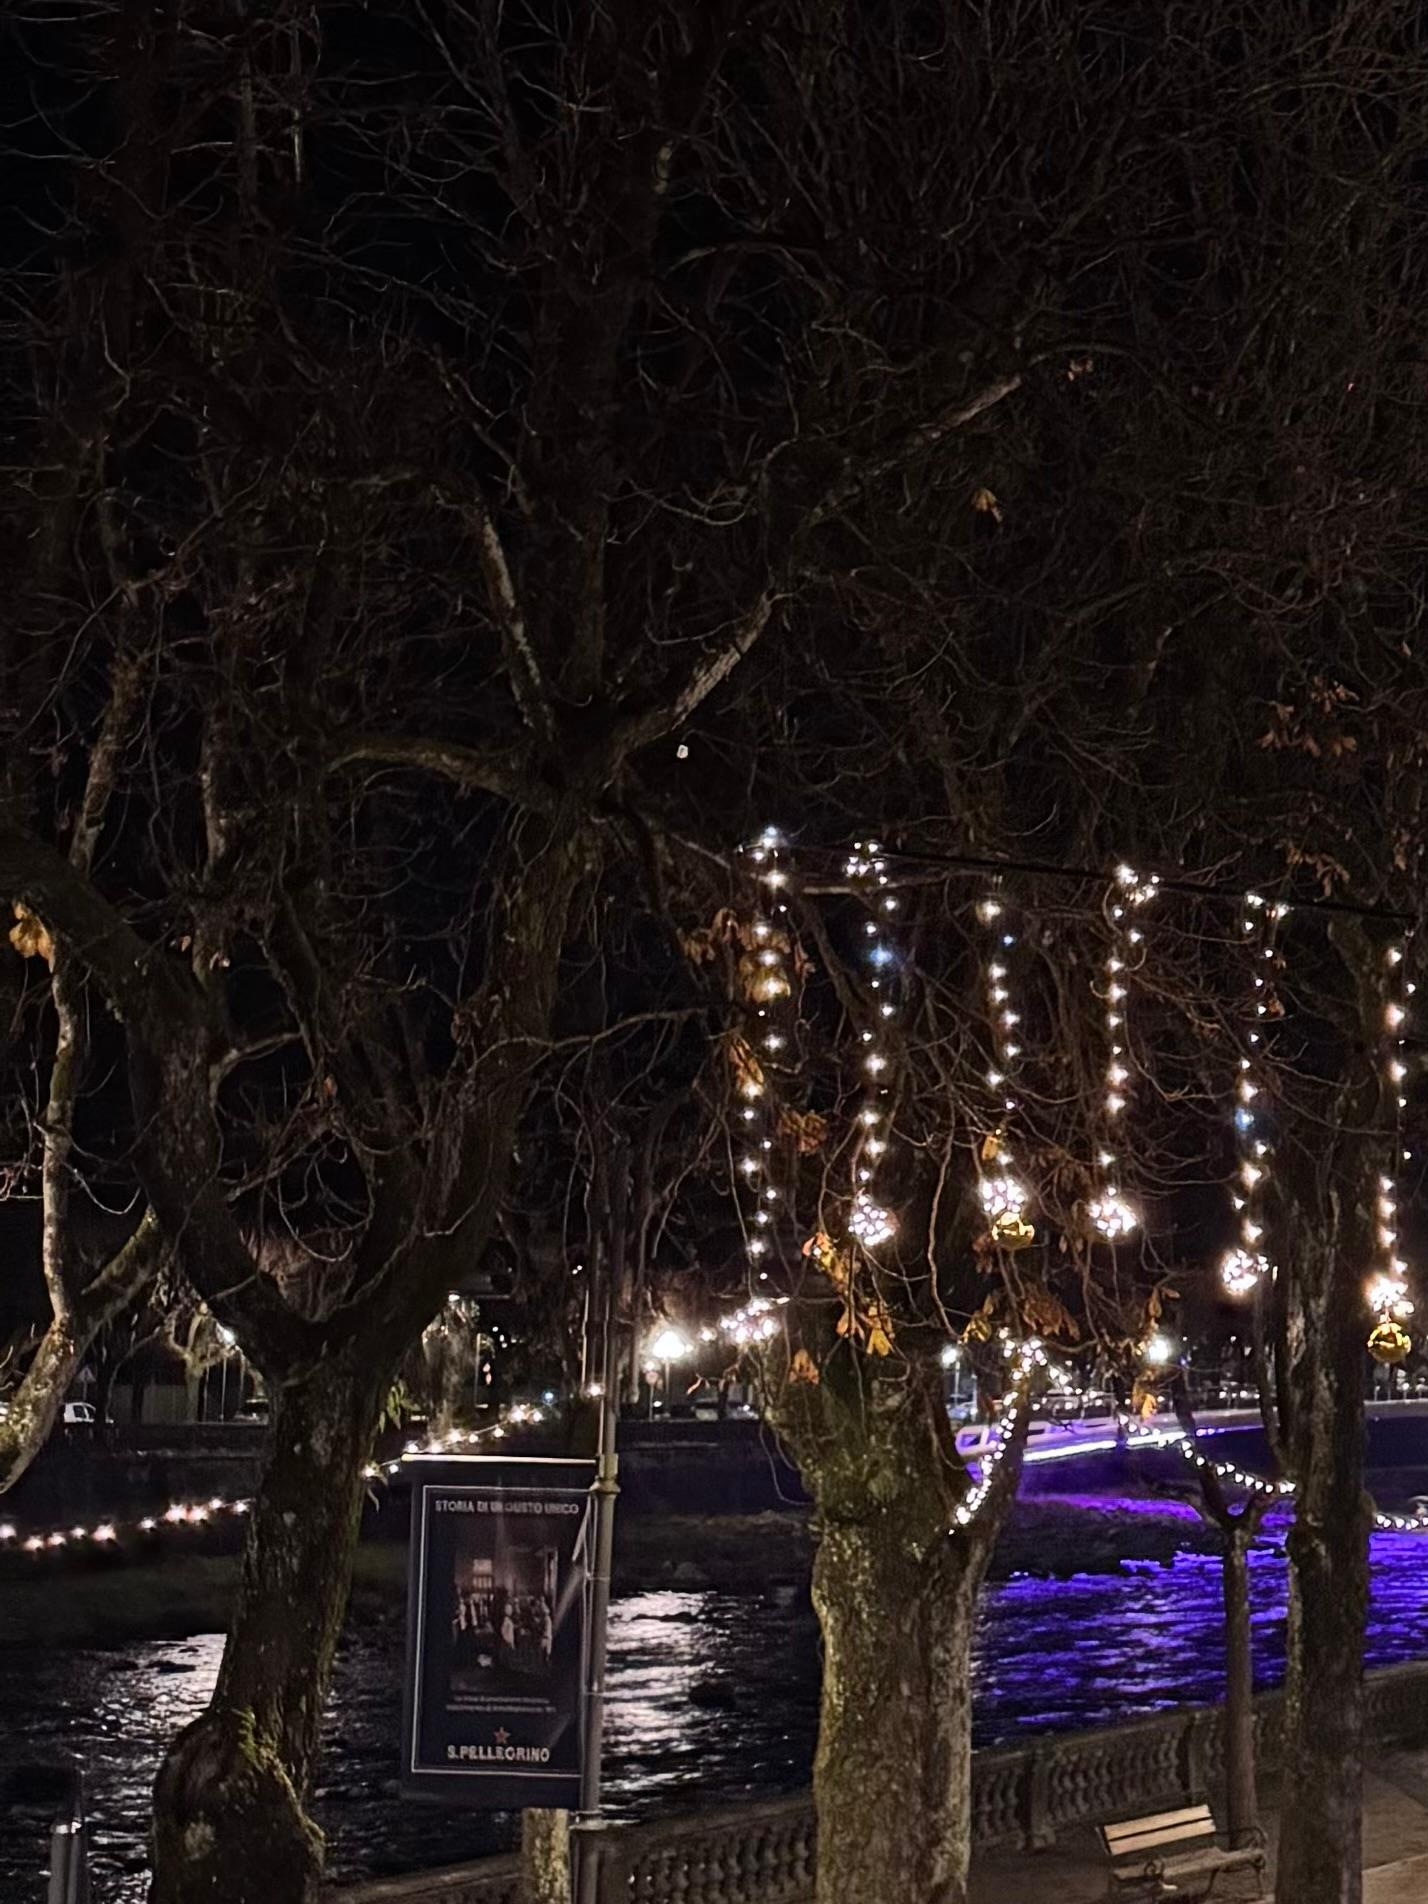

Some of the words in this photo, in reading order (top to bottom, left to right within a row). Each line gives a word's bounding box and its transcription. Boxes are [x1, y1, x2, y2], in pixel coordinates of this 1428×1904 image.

[435, 1499, 475, 1513] STORIA
[477, 1500, 488, 1513] DI
[544, 1502, 579, 1515] UNICO
